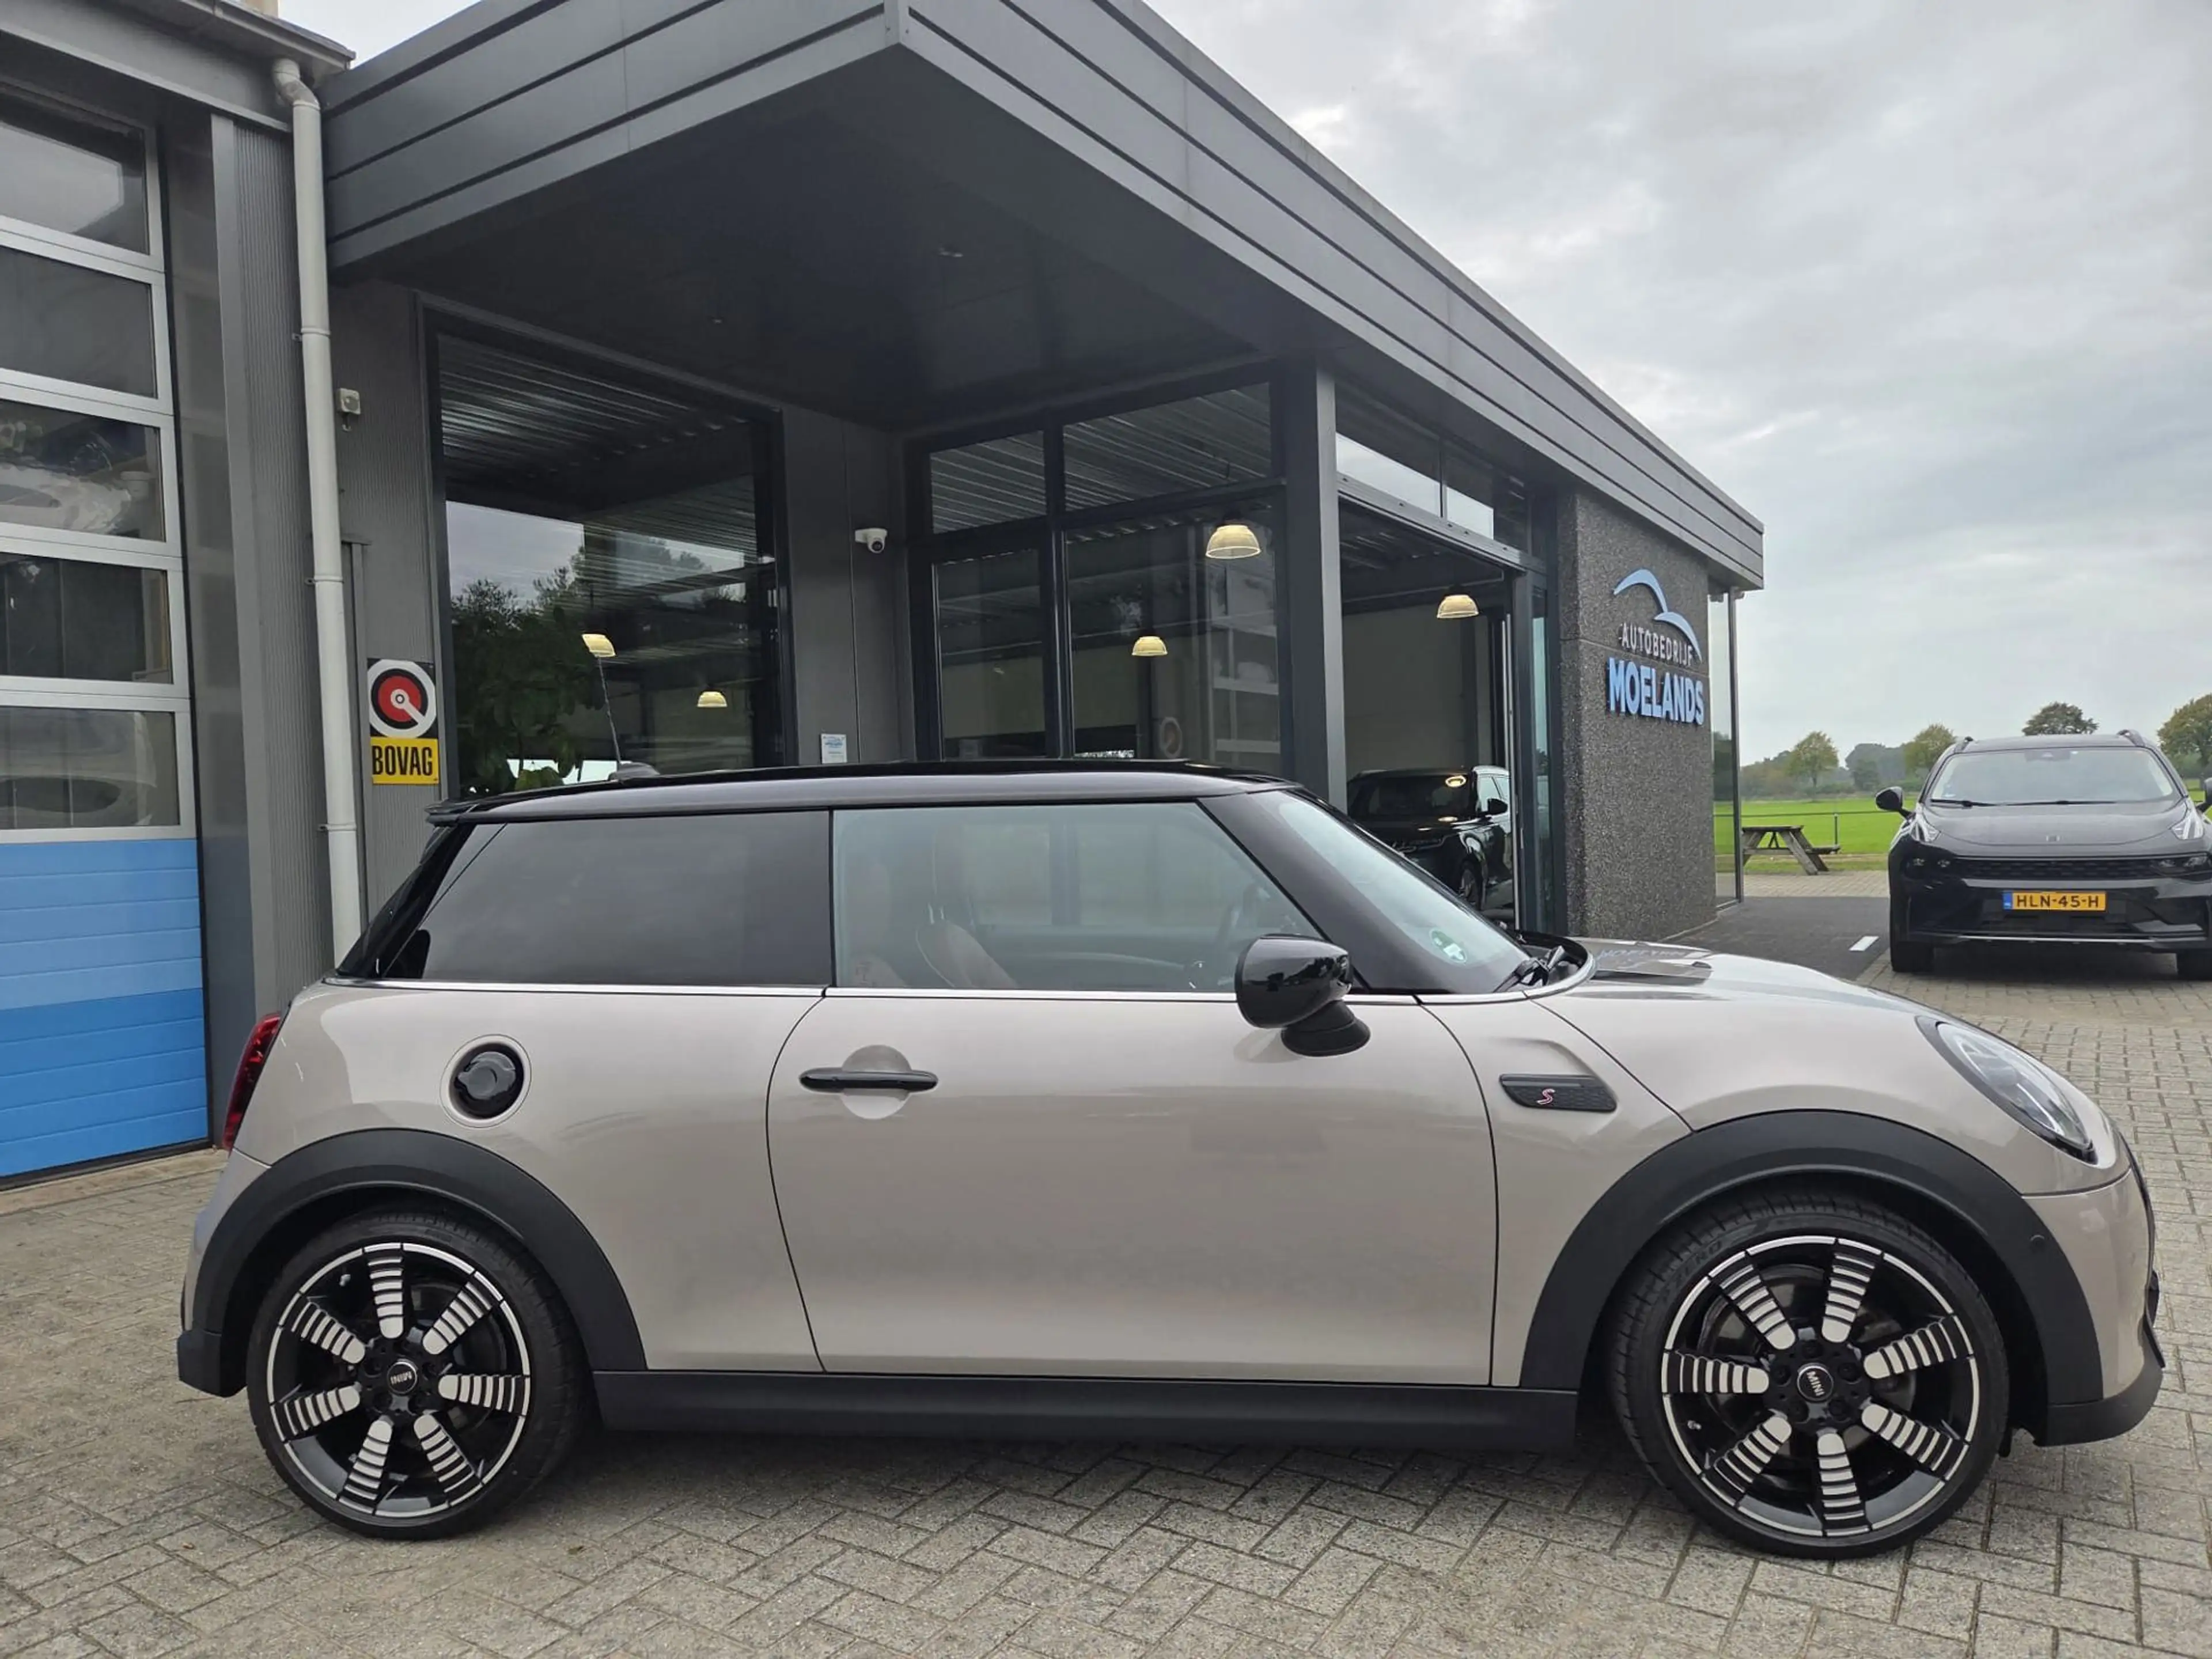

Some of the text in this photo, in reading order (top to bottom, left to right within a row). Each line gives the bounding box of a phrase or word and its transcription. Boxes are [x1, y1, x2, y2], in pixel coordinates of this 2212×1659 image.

[1621, 622, 1692, 666] AUTOBEDRIJF
[1608, 657, 1705, 725] MOELANDS
[372, 745, 433, 776] BOVAG
[2017, 895, 2099, 908] HLN-45-H
[1536, 1088, 1555, 1105] S
[1806, 1370, 1825, 1396] MINI
